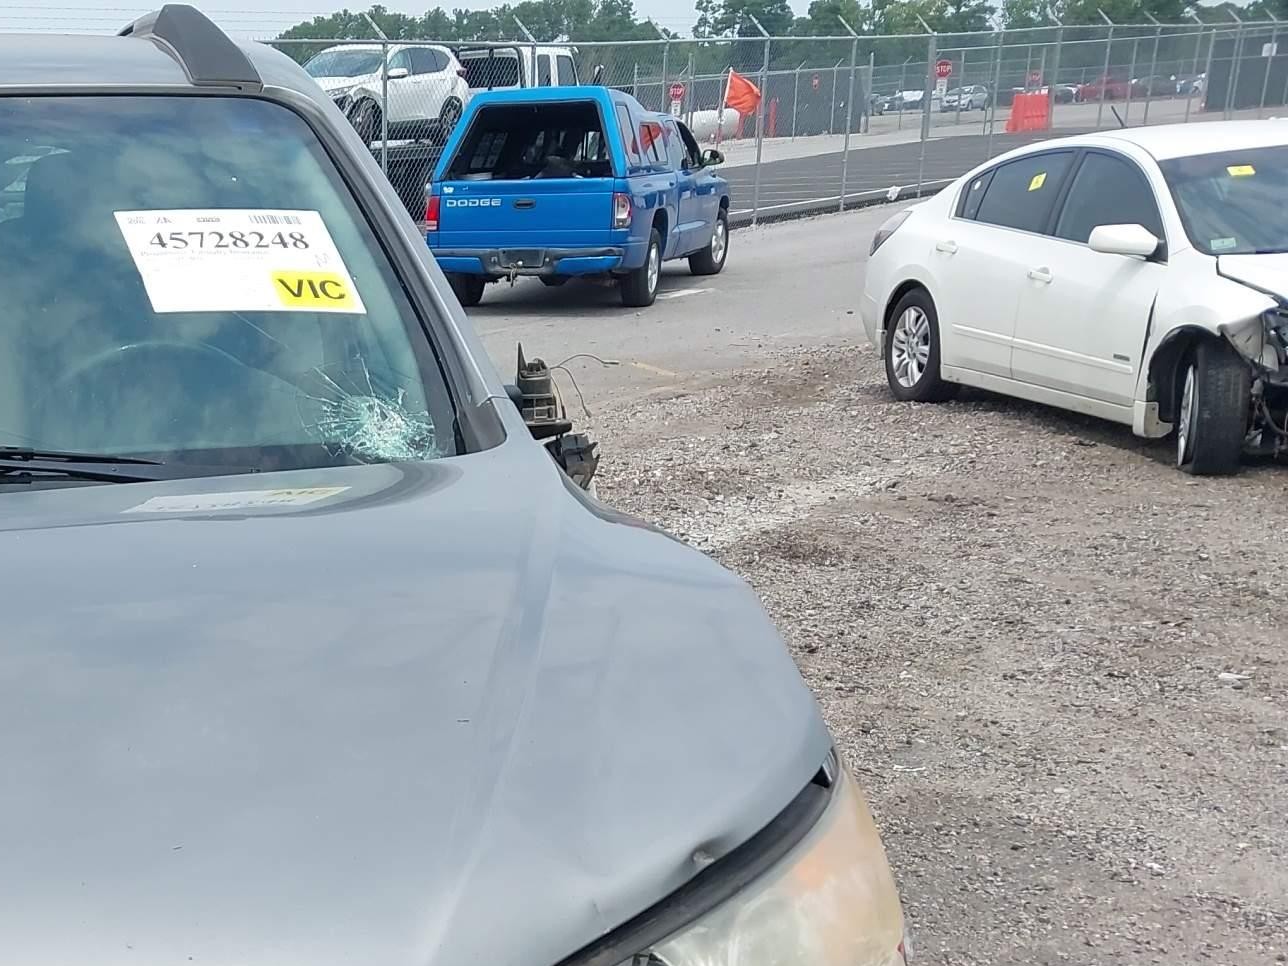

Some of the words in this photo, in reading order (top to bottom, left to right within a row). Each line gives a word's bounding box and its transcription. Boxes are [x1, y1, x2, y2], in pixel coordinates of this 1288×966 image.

[936, 65, 952, 73] STOP
[446, 198, 502, 208] DODGE
[149, 230, 310, 250] 45728248
[277, 278, 347, 300] VIC
